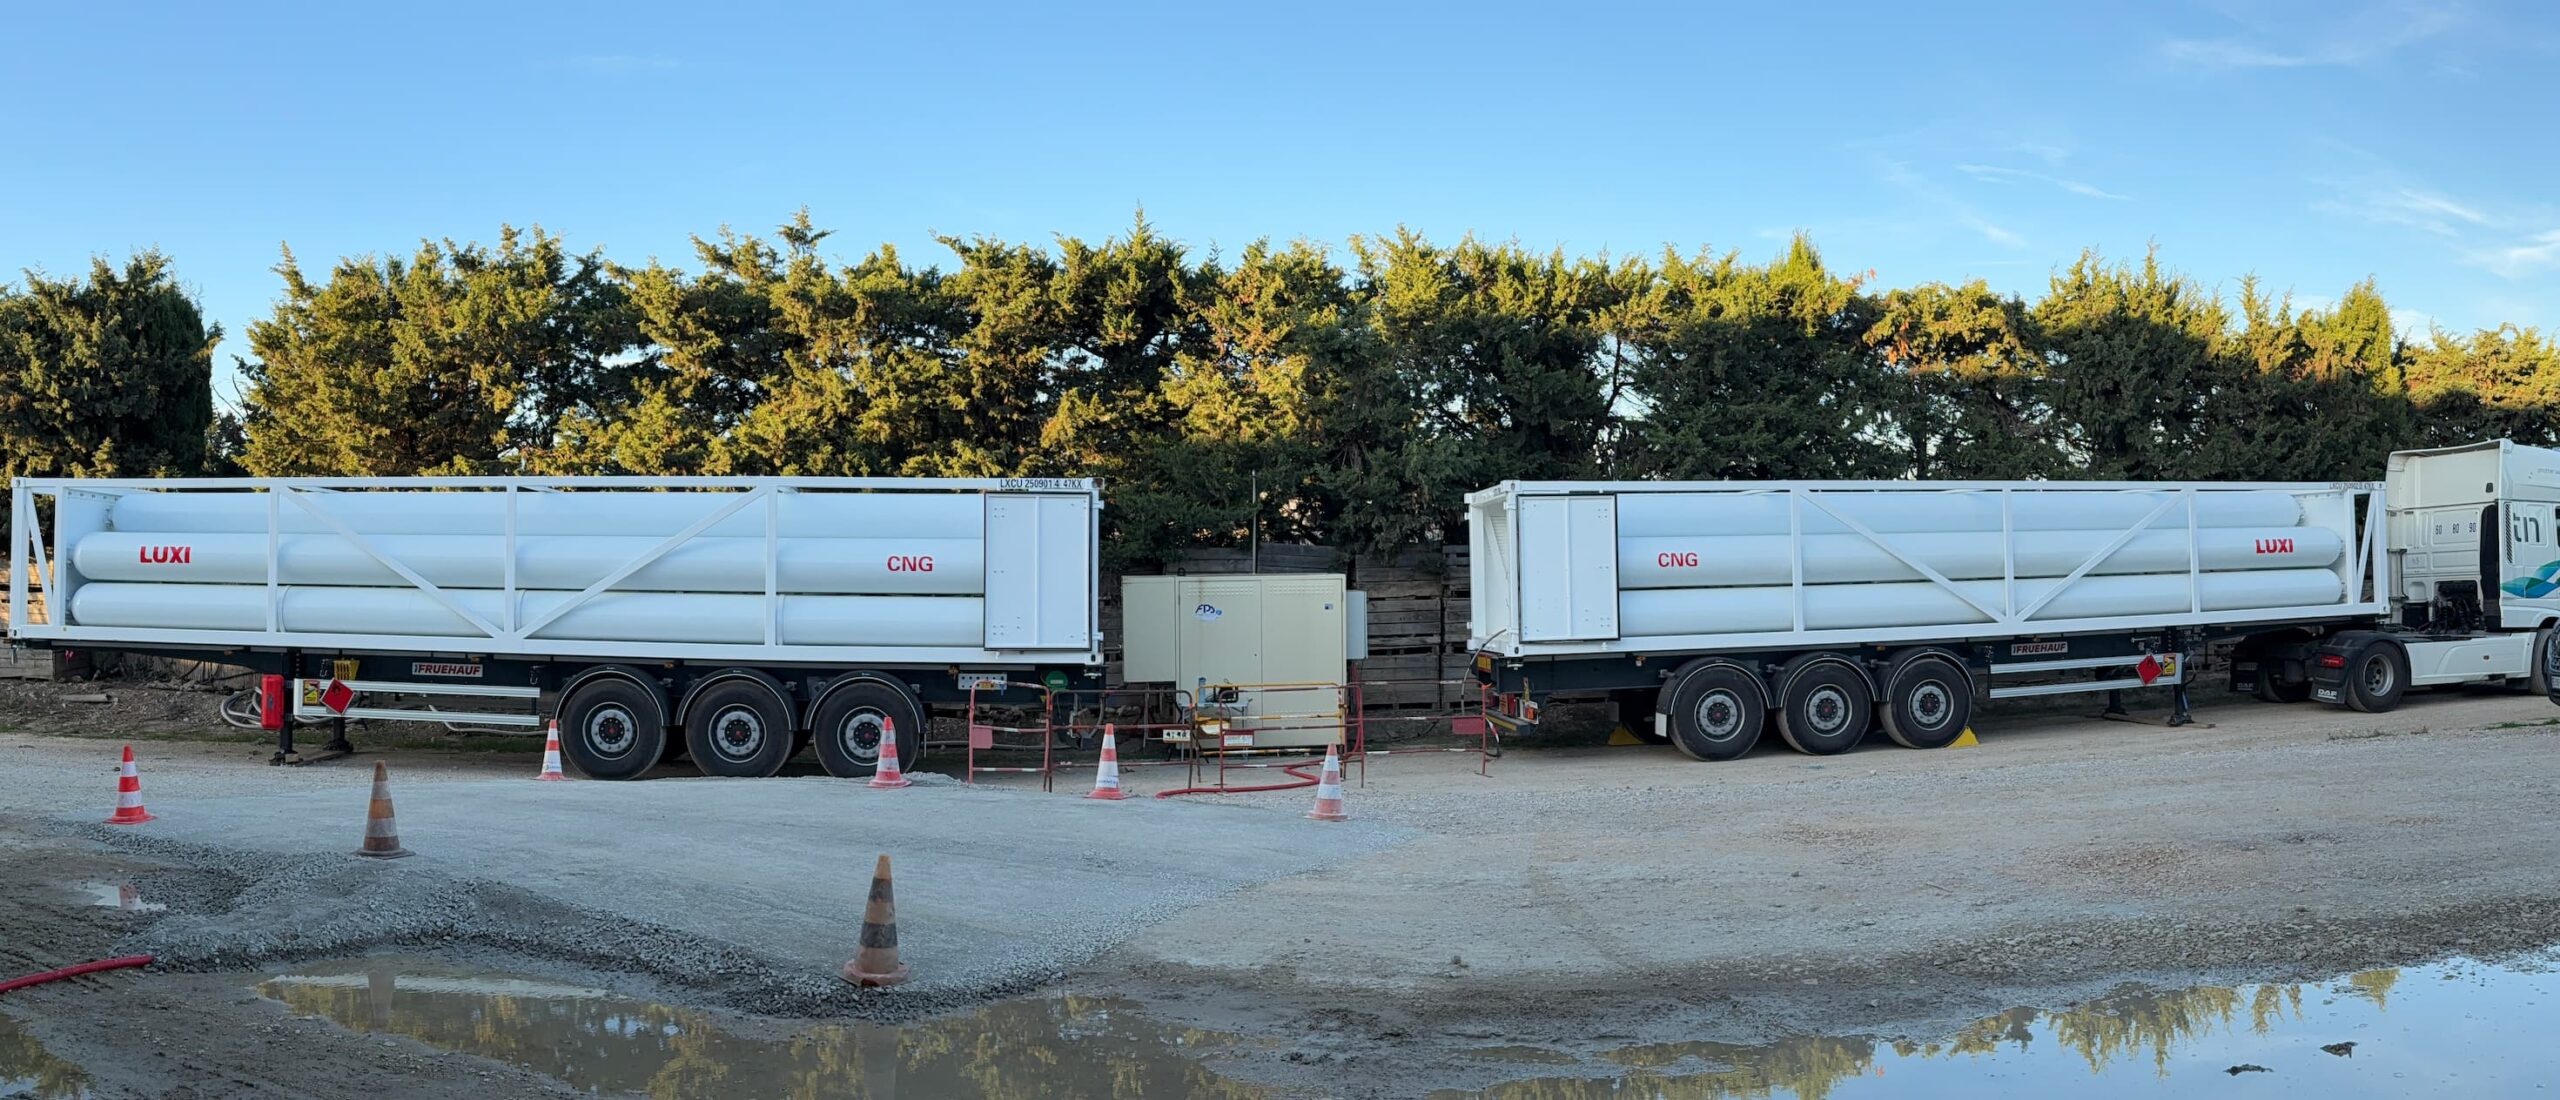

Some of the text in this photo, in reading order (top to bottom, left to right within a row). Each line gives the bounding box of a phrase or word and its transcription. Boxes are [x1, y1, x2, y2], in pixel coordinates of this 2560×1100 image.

[1000, 479, 1022, 488] LXCU
[1024, 479, 1052, 488] 250901
[1063, 479, 1082, 488] 47KX
[2469, 522, 2477, 533] 90
[2255, 538, 2294, 553] LUXI
[140, 546, 191, 563] LUXI
[1658, 552, 1698, 567] CNG
[887, 555, 933, 571] CNG
[2016, 643, 2066, 653] FRUEHAUF
[418, 664, 480, 675] FRUEHAUF
[2317, 688, 2338, 697] DAF
